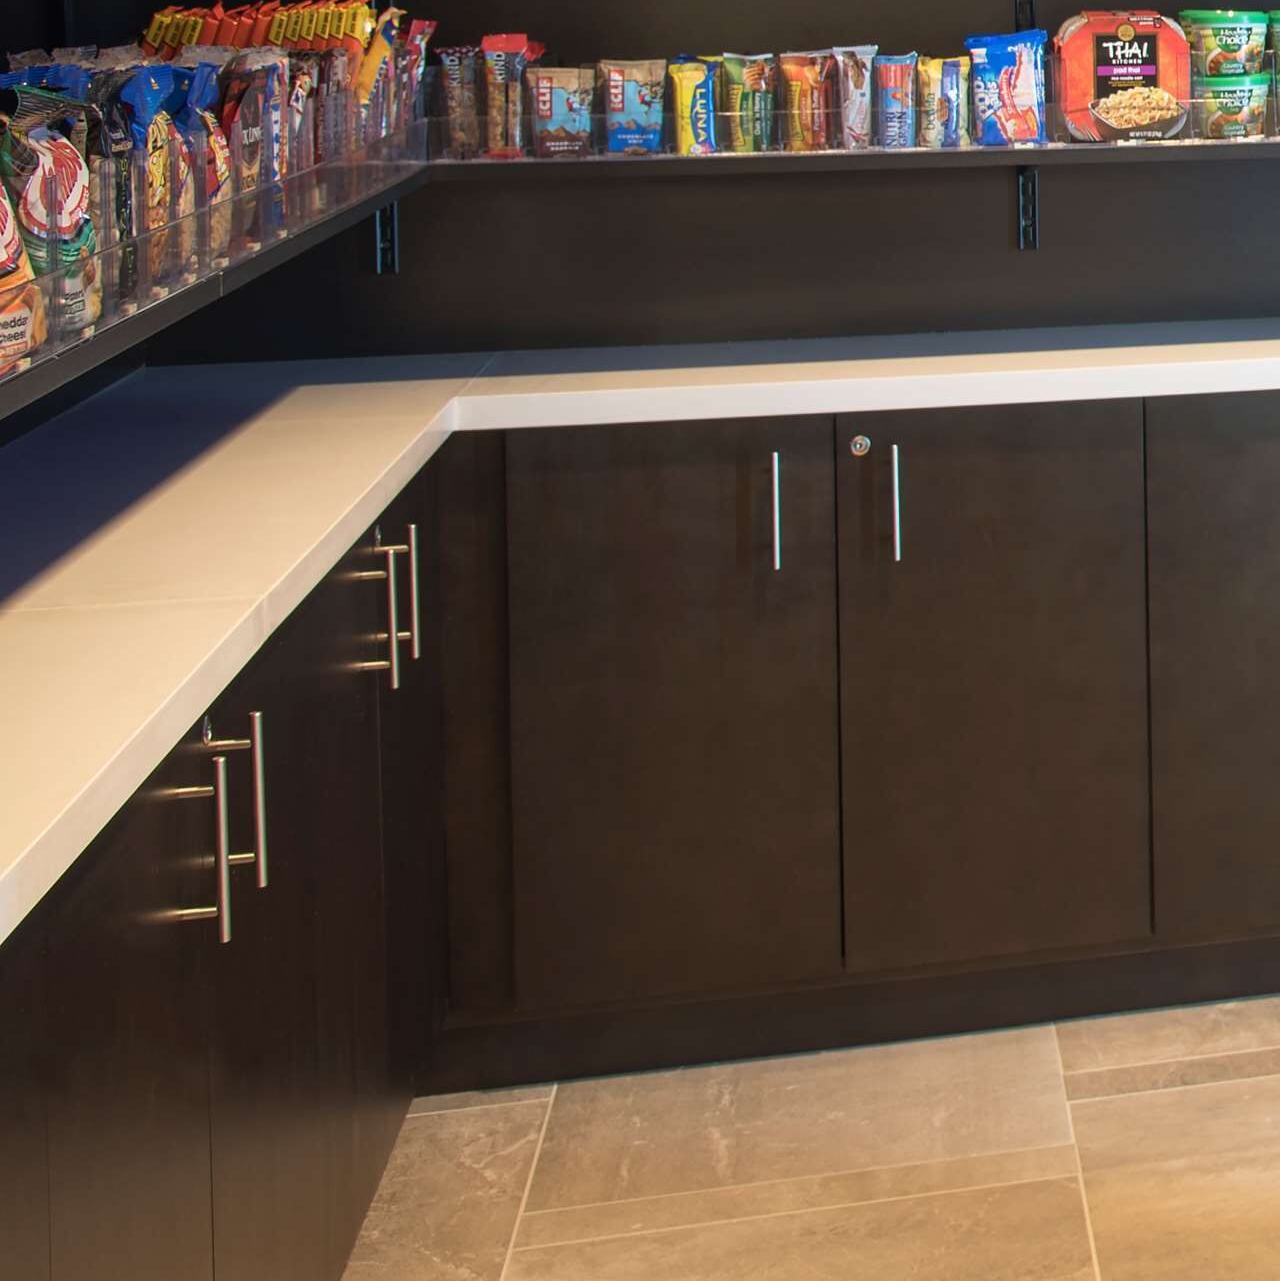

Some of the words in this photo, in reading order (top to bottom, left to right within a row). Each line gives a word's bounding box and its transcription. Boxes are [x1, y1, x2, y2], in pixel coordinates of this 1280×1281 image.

[1102, 41, 1148, 59] THAI
[1216, 33, 1249, 45] Choice
[447, 56, 462, 87] KIND
[493, 51, 506, 83] KIND
[1113, 66, 1127, 74] pad
[538, 78, 551, 110] CLIF
[609, 70, 624, 103] CLIF
[1216, 96, 1249, 108] Choice
[695, 88, 708, 143] LUNA
[885, 110, 896, 147] NUTRI
